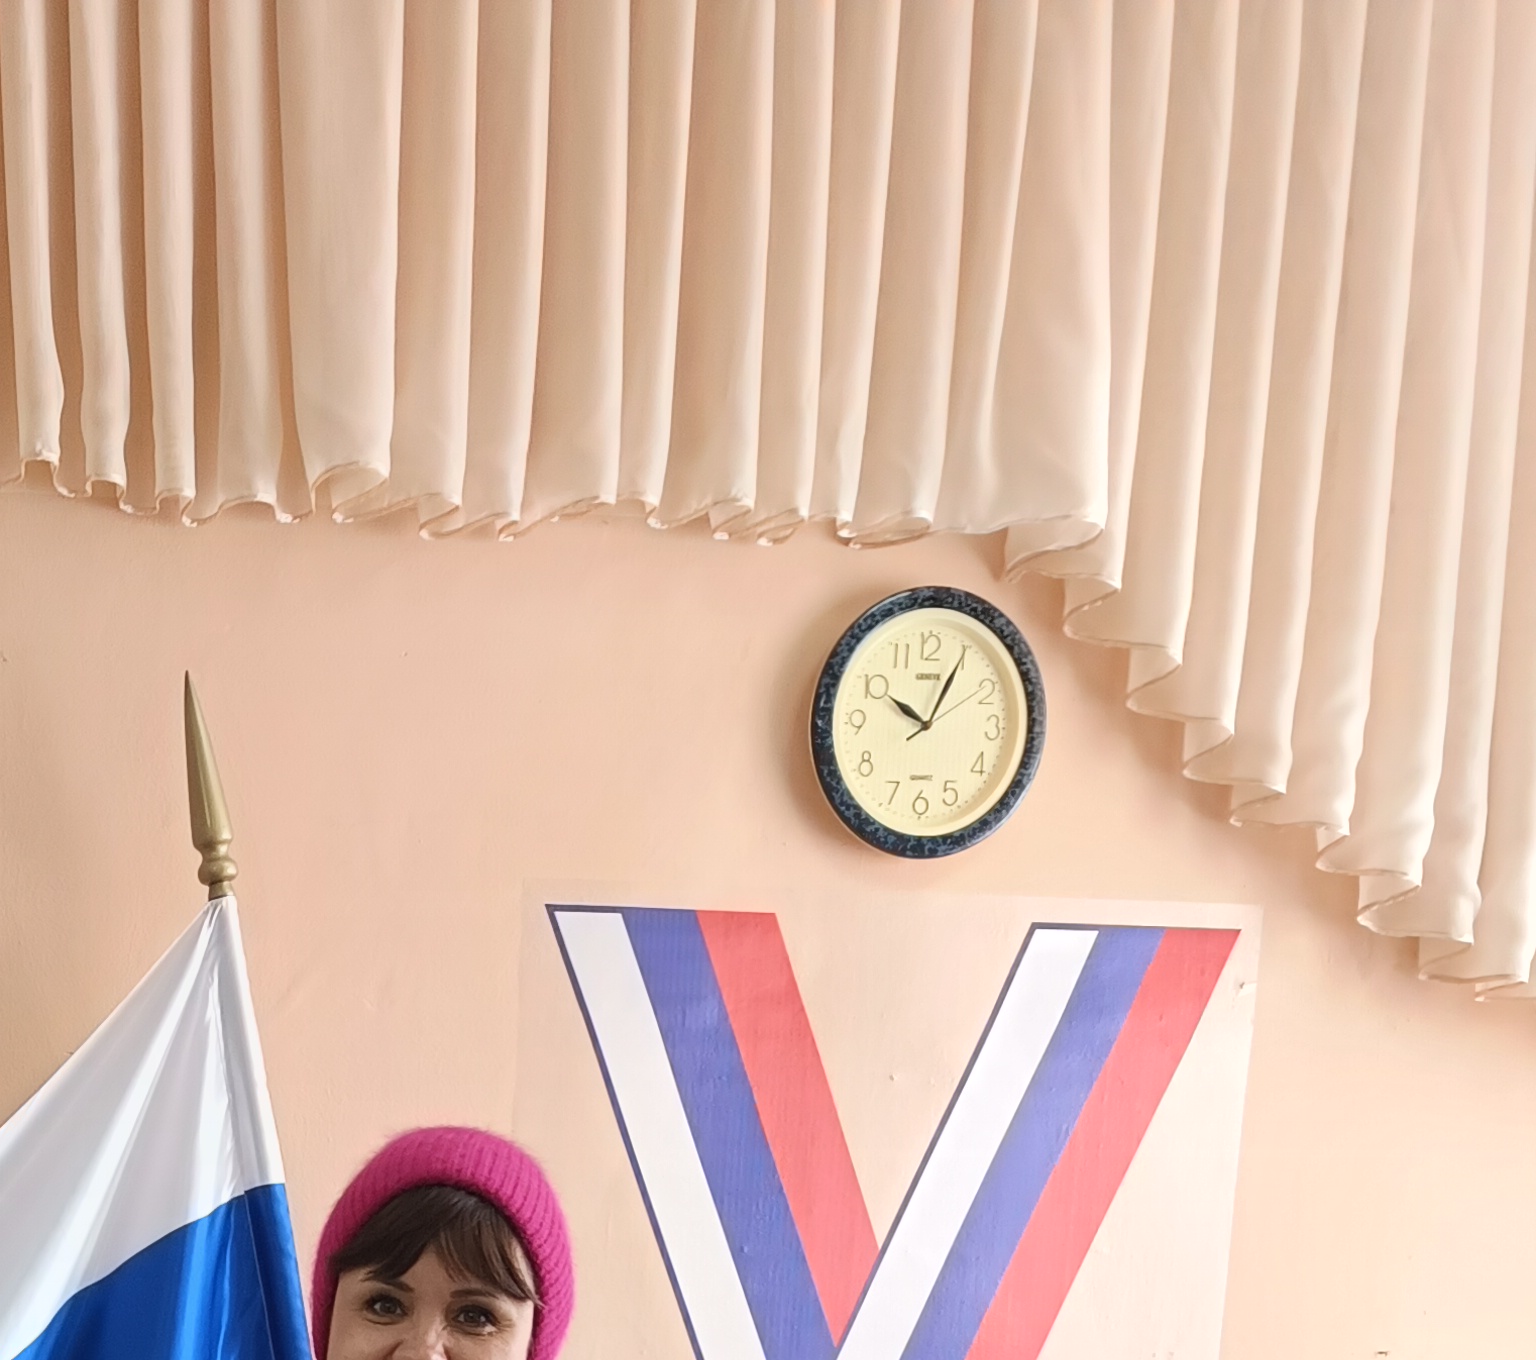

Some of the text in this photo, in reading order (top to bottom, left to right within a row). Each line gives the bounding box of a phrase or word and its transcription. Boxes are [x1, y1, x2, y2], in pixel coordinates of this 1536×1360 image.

[893, 642, 910, 669] 11
[920, 631, 942, 661] 12
[864, 674, 890, 700] 10
[978, 678, 996, 705] 2
[849, 709, 867, 735] 9
[984, 714, 1001, 741] 3
[857, 750, 874, 777] 8
[969, 751, 986, 777] 4
[884, 780, 901, 806] 7
[913, 789, 930, 816] 6
[942, 780, 959, 807] 5
